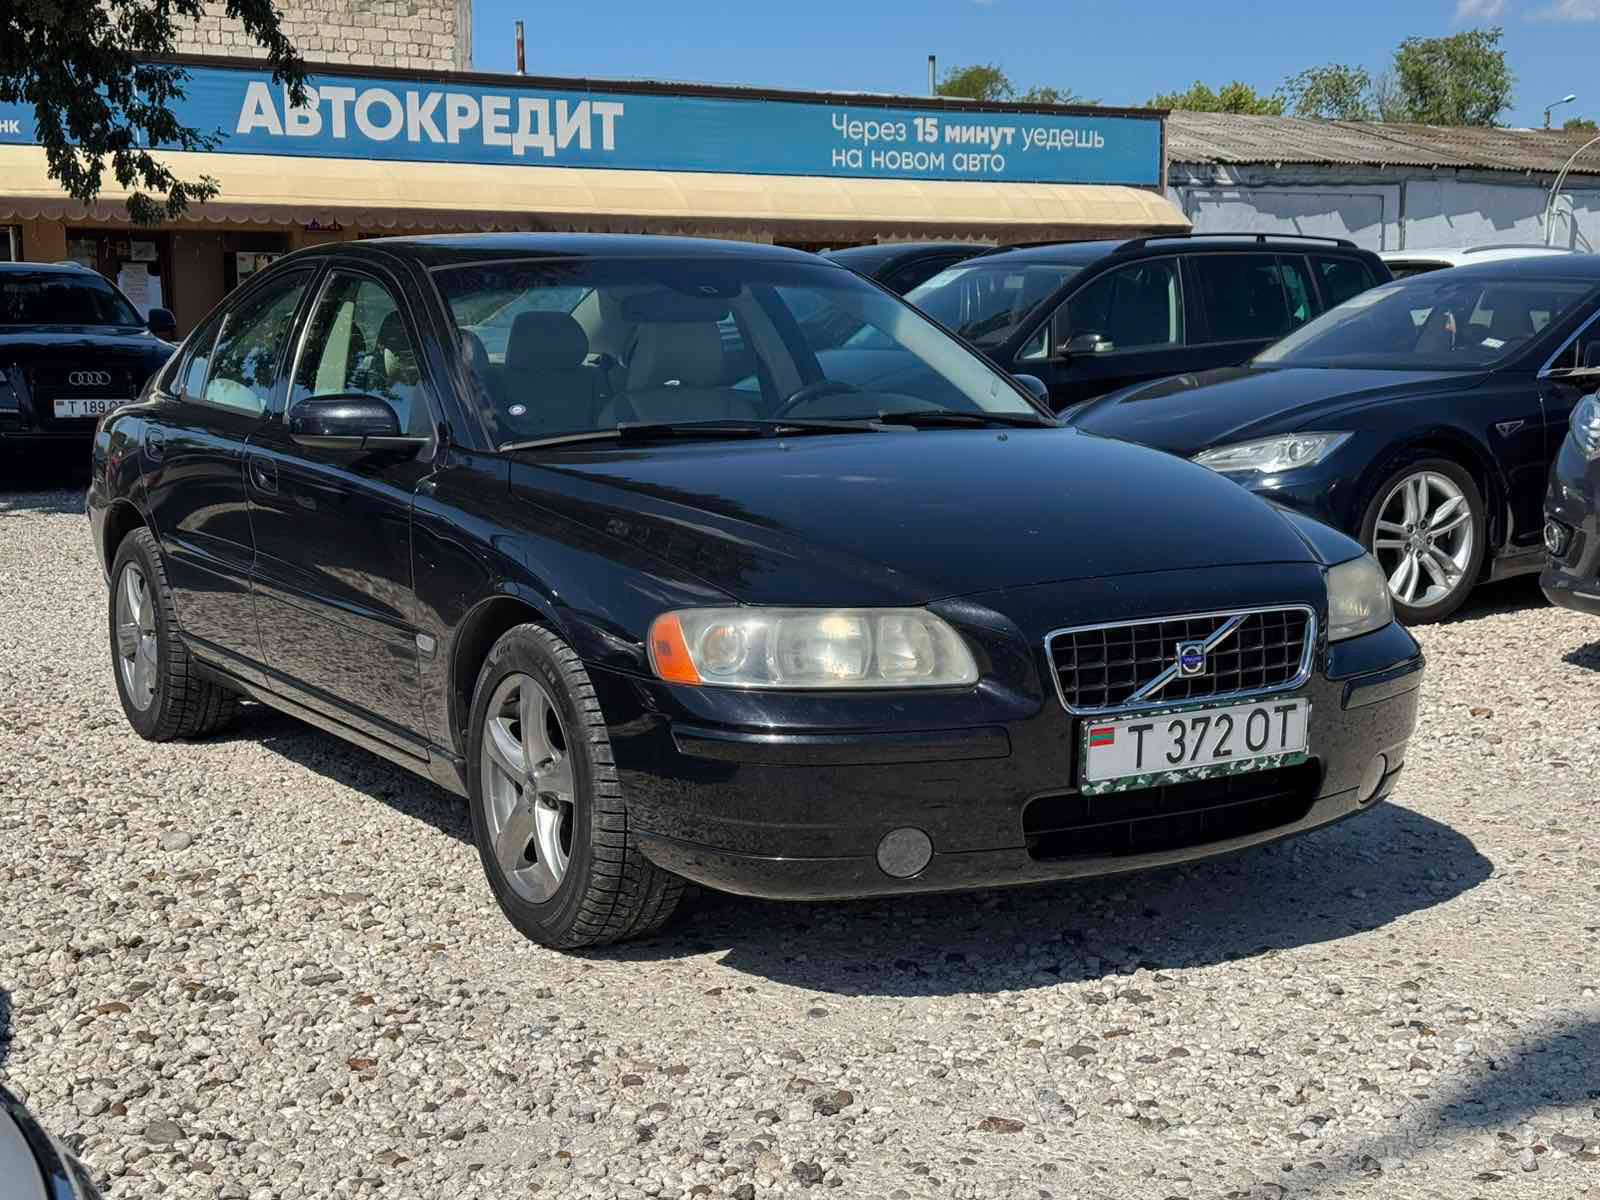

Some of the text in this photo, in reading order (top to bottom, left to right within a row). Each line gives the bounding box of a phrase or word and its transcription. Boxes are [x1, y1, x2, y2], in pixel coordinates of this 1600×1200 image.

[236, 81, 624, 157] АВТОКРЕДИТ
[831, 113, 1105, 152] Через 15 минут уедешь
[831, 148, 1006, 172] на новом авто
[68, 401, 77, 414] T
[82, 400, 105, 414] 189
[1128, 723, 1154, 769] T
[1165, 712, 1234, 765] 372
